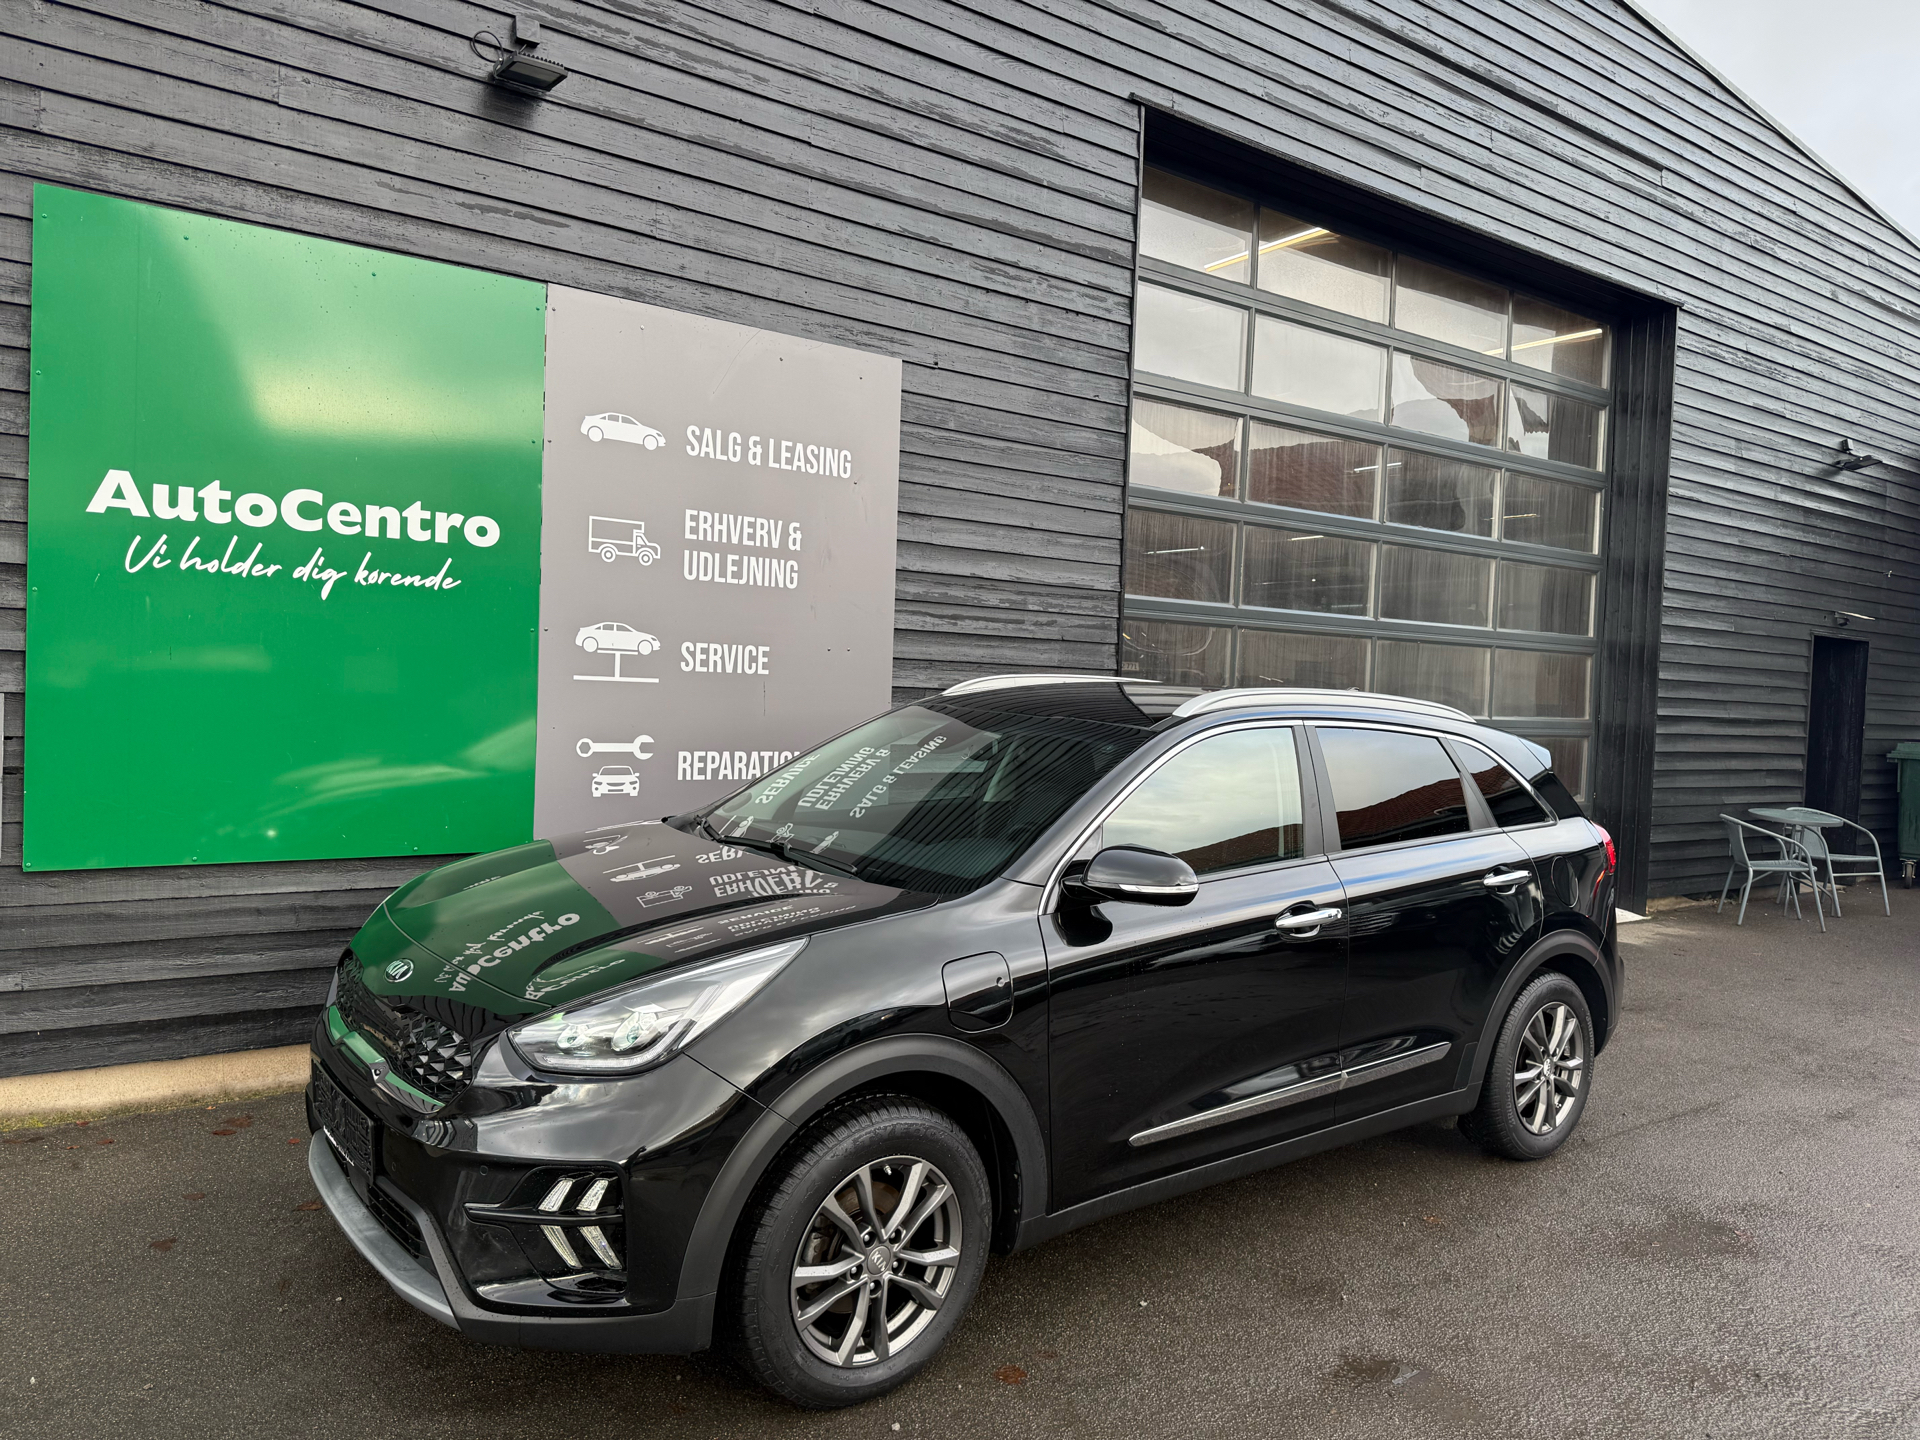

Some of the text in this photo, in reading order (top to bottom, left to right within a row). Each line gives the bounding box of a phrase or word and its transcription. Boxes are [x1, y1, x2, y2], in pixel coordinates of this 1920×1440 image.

[686, 424, 852, 479] SALG & LEASING
[85, 469, 501, 548] AutoCentro
[684, 509, 802, 551] ERHVERV &
[125, 534, 172, 574] Vi
[179, 534, 283, 578] holder
[292, 546, 348, 600] dig
[683, 550, 799, 589] UDLEJNING
[680, 641, 770, 675] SERVICE
[871, 1251, 887, 1271] KIA
